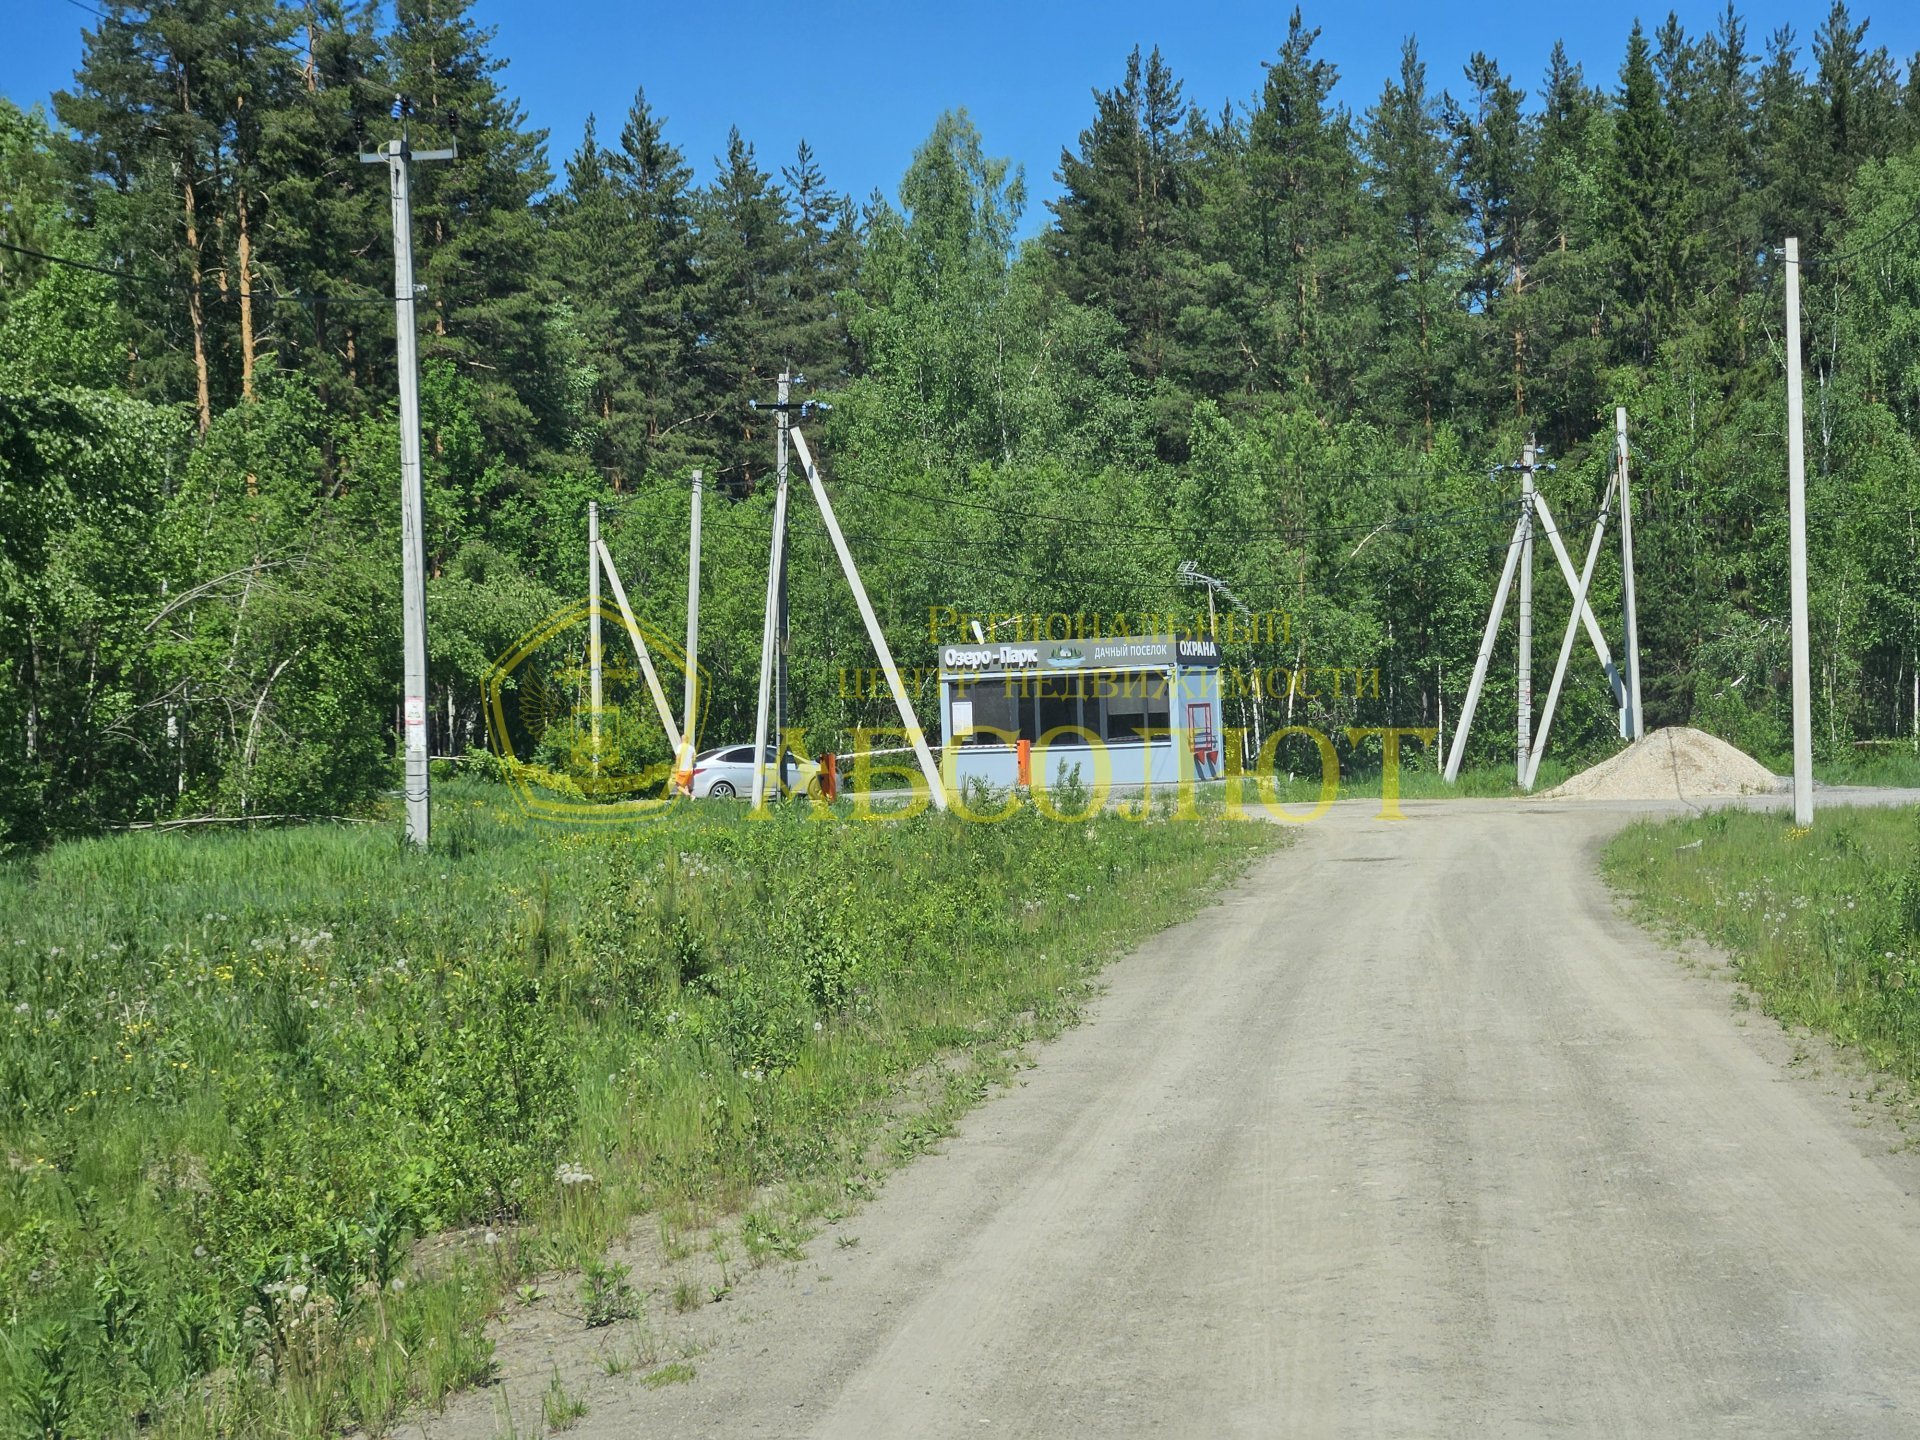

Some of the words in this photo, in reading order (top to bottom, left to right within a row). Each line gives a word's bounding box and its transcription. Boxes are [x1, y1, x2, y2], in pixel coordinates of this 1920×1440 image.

[945, 646, 1038, 668] Озеро-Парк
[1094, 644, 1128, 660] ДАЧНЫЙ
[1130, 643, 1168, 657] ПОСЕЛОК
[1179, 640, 1217, 657] ОХРАНА
